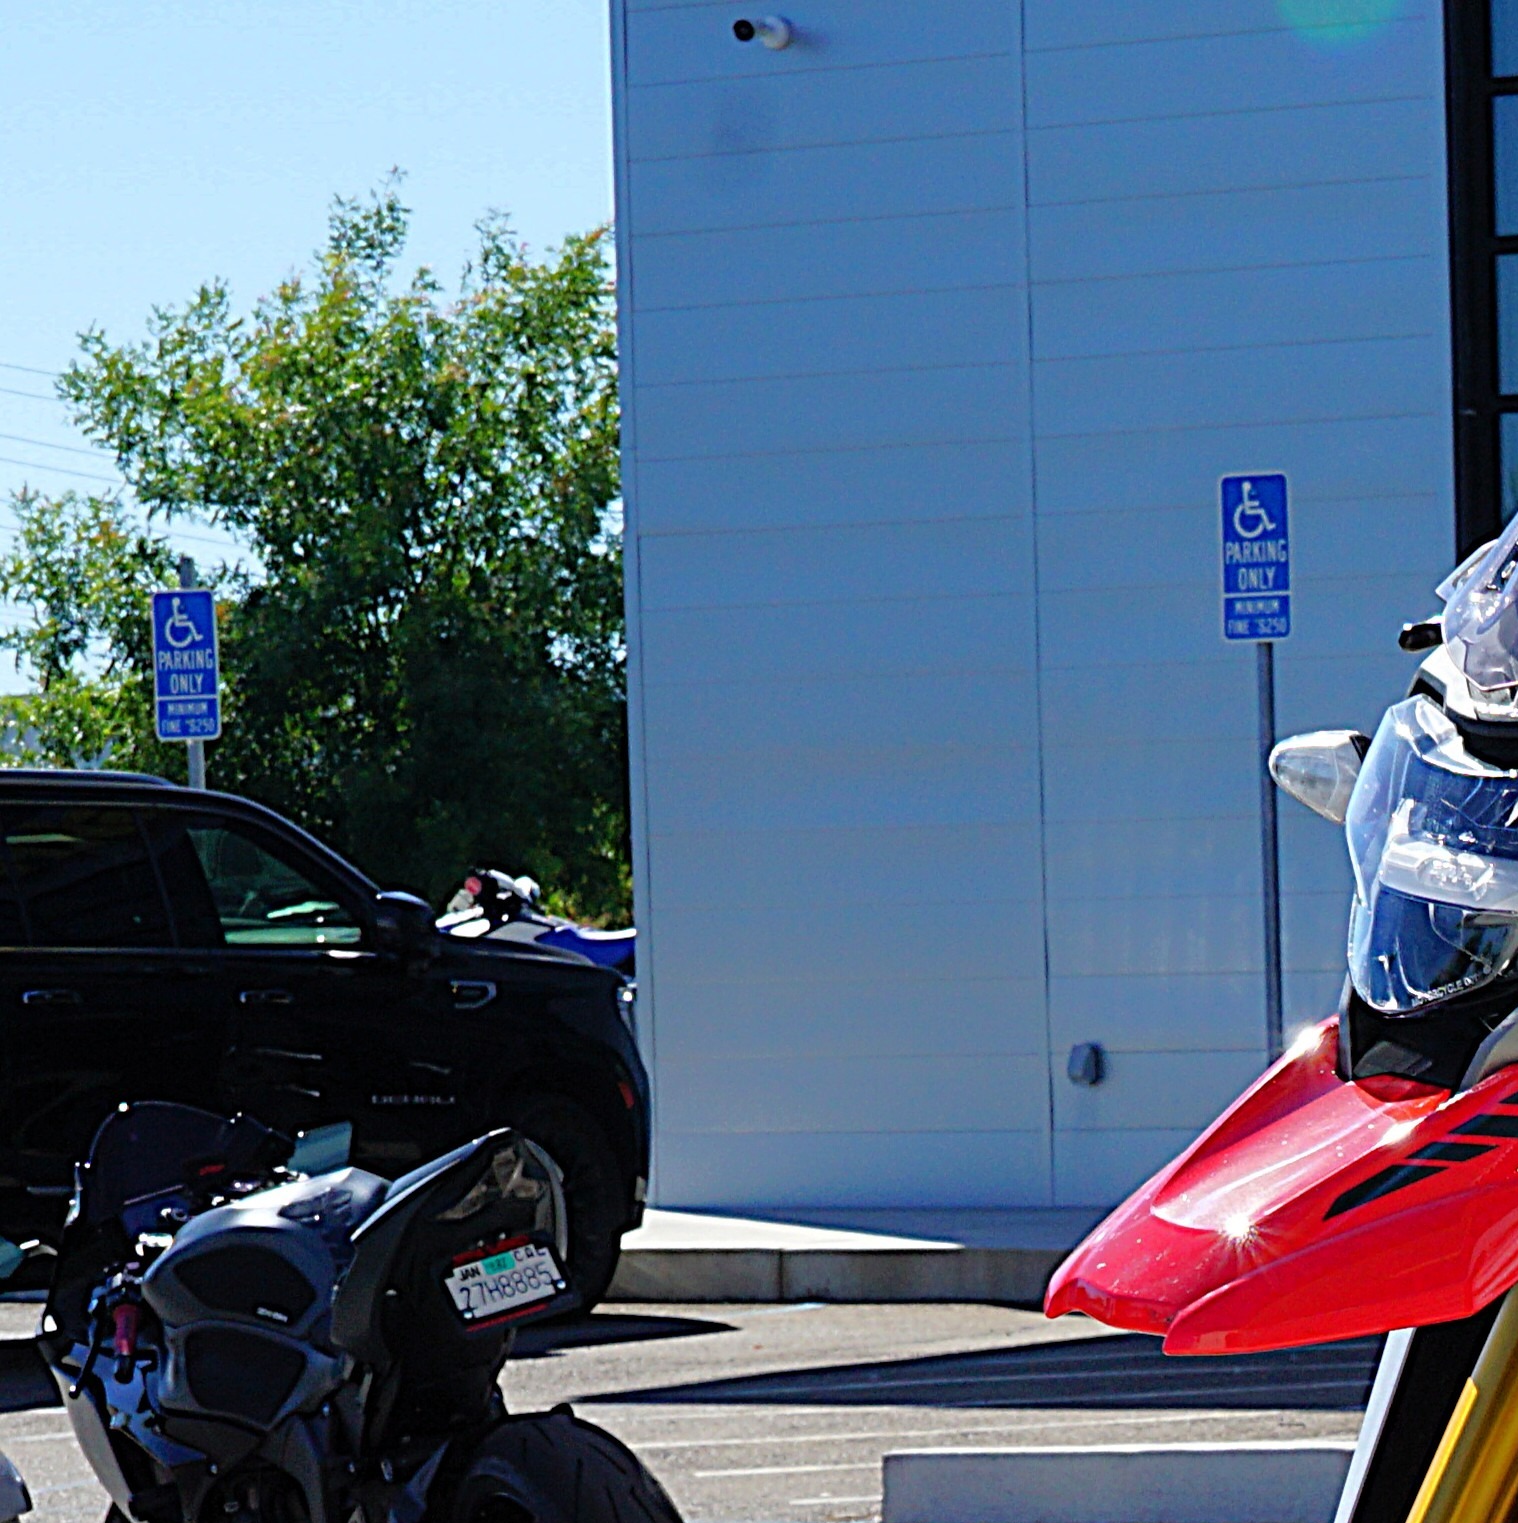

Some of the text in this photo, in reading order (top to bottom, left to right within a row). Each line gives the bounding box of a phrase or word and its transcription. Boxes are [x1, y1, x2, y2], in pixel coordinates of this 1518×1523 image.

[1225, 540, 1287, 565] PARKING
[1238, 566, 1276, 590] ONLY
[158, 649, 213, 671] PARKING
[170, 673, 204, 694] ONLY
[167, 702, 208, 716] MINIMUM
[161, 719, 182, 733] FINE
[459, 1266, 481, 1282] JAN
[458, 1261, 553, 1310] 27H8885
